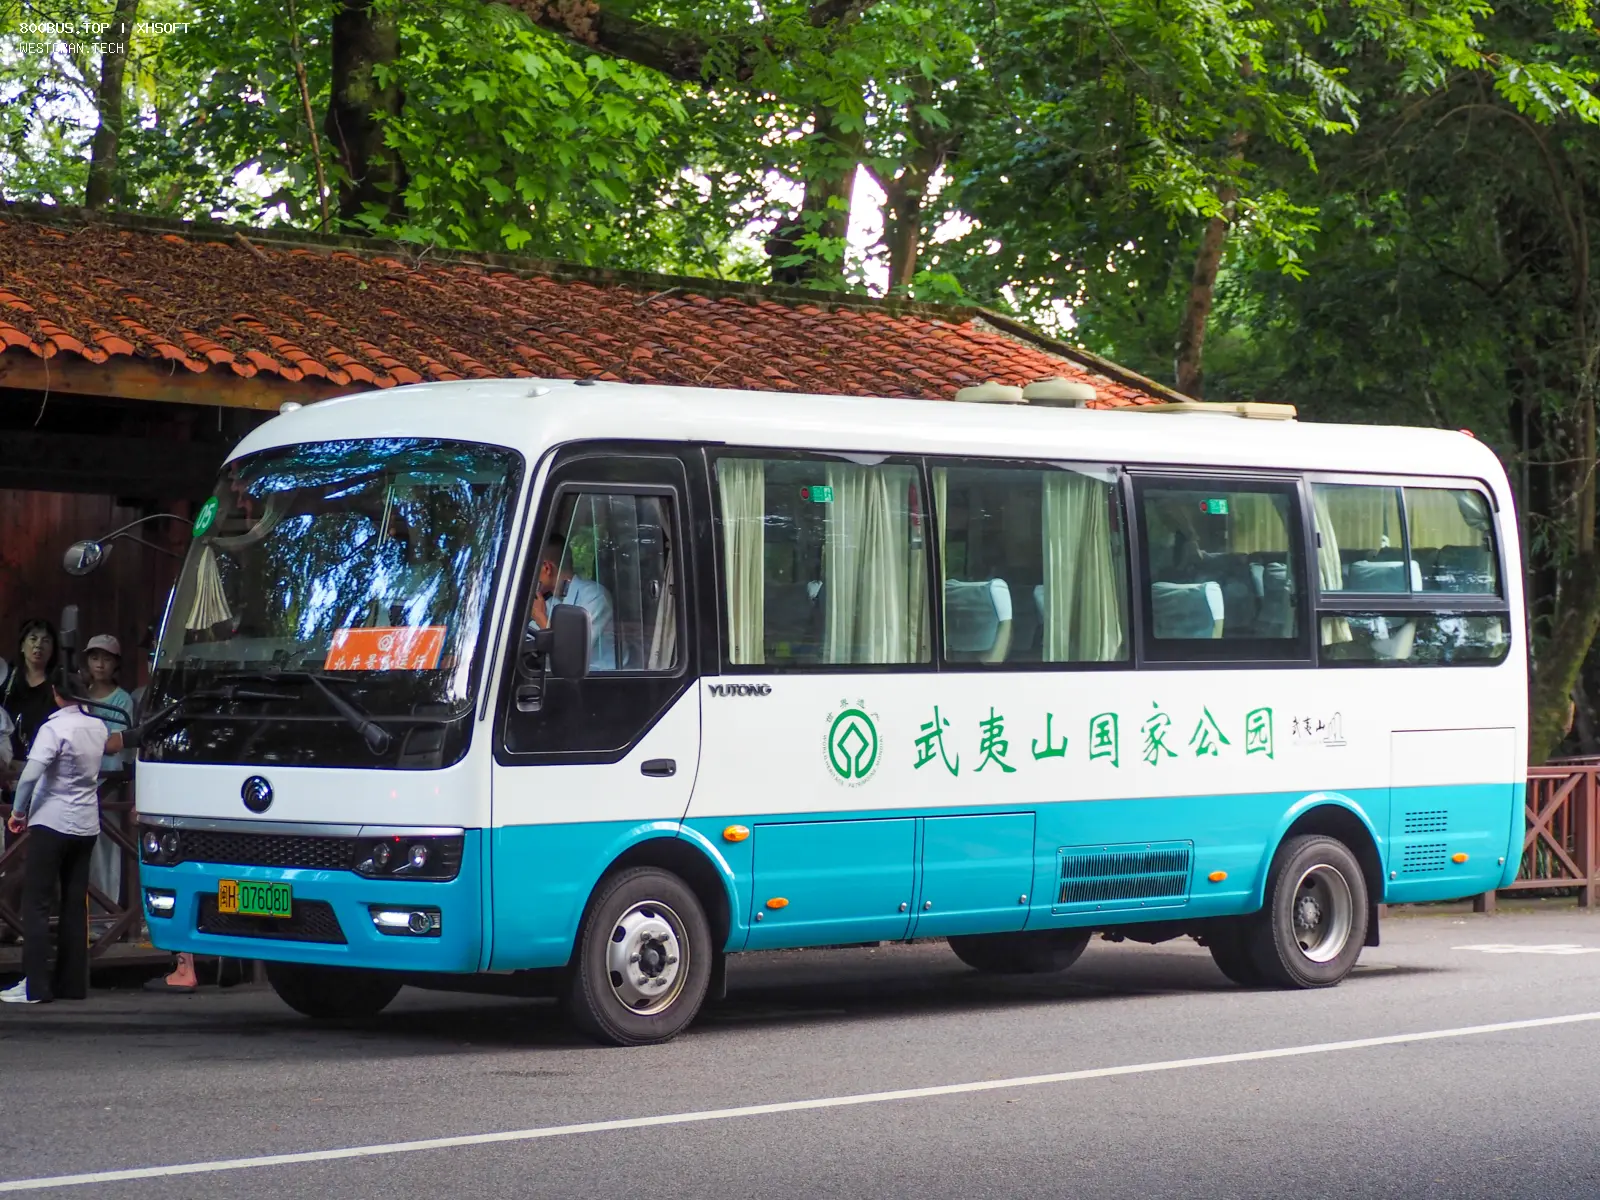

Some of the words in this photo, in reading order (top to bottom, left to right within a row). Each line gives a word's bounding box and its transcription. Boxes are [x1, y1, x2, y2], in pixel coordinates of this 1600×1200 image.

[195, 503, 216, 530] 05
[707, 683, 773, 698] YUTONG
[912, 700, 1275, 778] 武夷山国家公园
